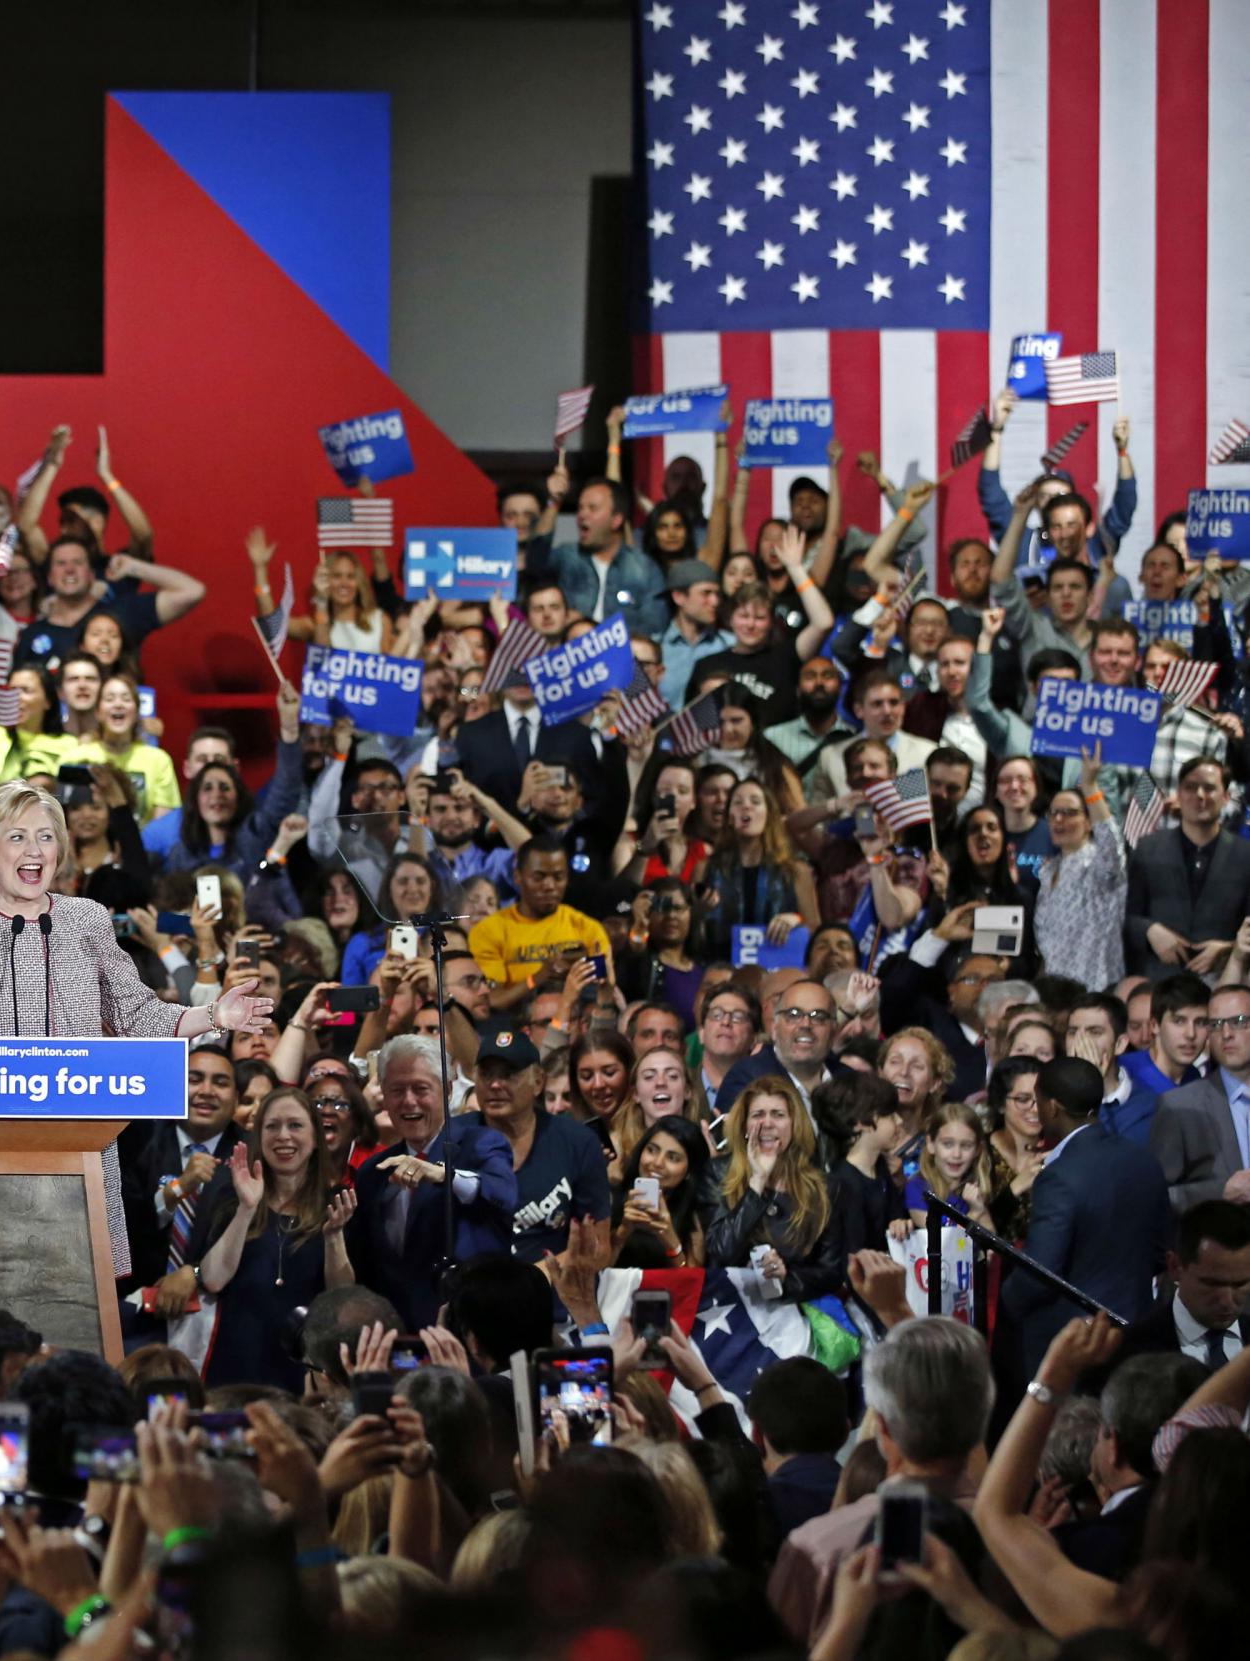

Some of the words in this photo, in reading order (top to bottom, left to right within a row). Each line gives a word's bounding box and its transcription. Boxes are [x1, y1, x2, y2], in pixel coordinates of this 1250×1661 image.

[745, 401, 831, 427] Fighting
[771, 427, 798, 445] us
[348, 445, 375, 467] us
[1188, 490, 1250, 519] Fightin
[1208, 519, 1233, 538] us
[457, 555, 512, 579] Hillary
[525, 619, 628, 684] Fighting
[307, 645, 421, 692] Fighting
[534, 677, 575, 706] for
[577, 661, 609, 689] us
[303, 670, 342, 698] for
[344, 683, 378, 706] us
[1040, 680, 1159, 724] Fighting
[1036, 704, 1078, 733] for
[1081, 716, 1114, 737] us
[55, 1066, 103, 1096] for
[108, 1074, 147, 1096] us
[512, 1176, 573, 1234] Hillary
